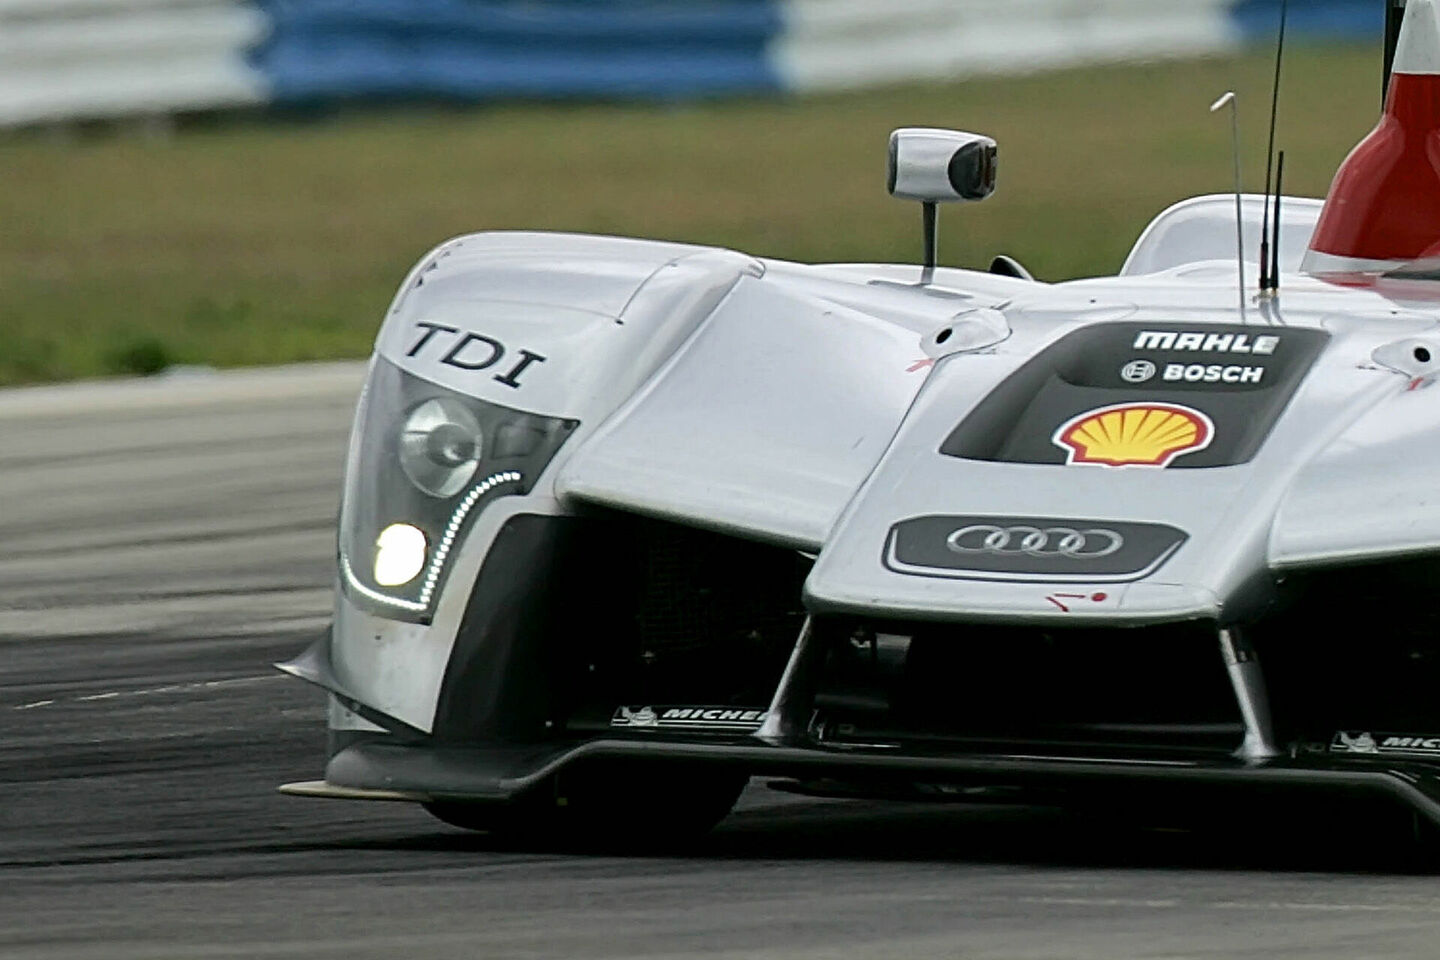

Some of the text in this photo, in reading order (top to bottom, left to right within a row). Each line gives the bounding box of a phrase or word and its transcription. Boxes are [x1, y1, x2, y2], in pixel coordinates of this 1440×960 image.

[1133, 331, 1280, 355] MAHLE
[406, 322, 547, 389] TDI
[1163, 364, 1264, 383] BOSCH
